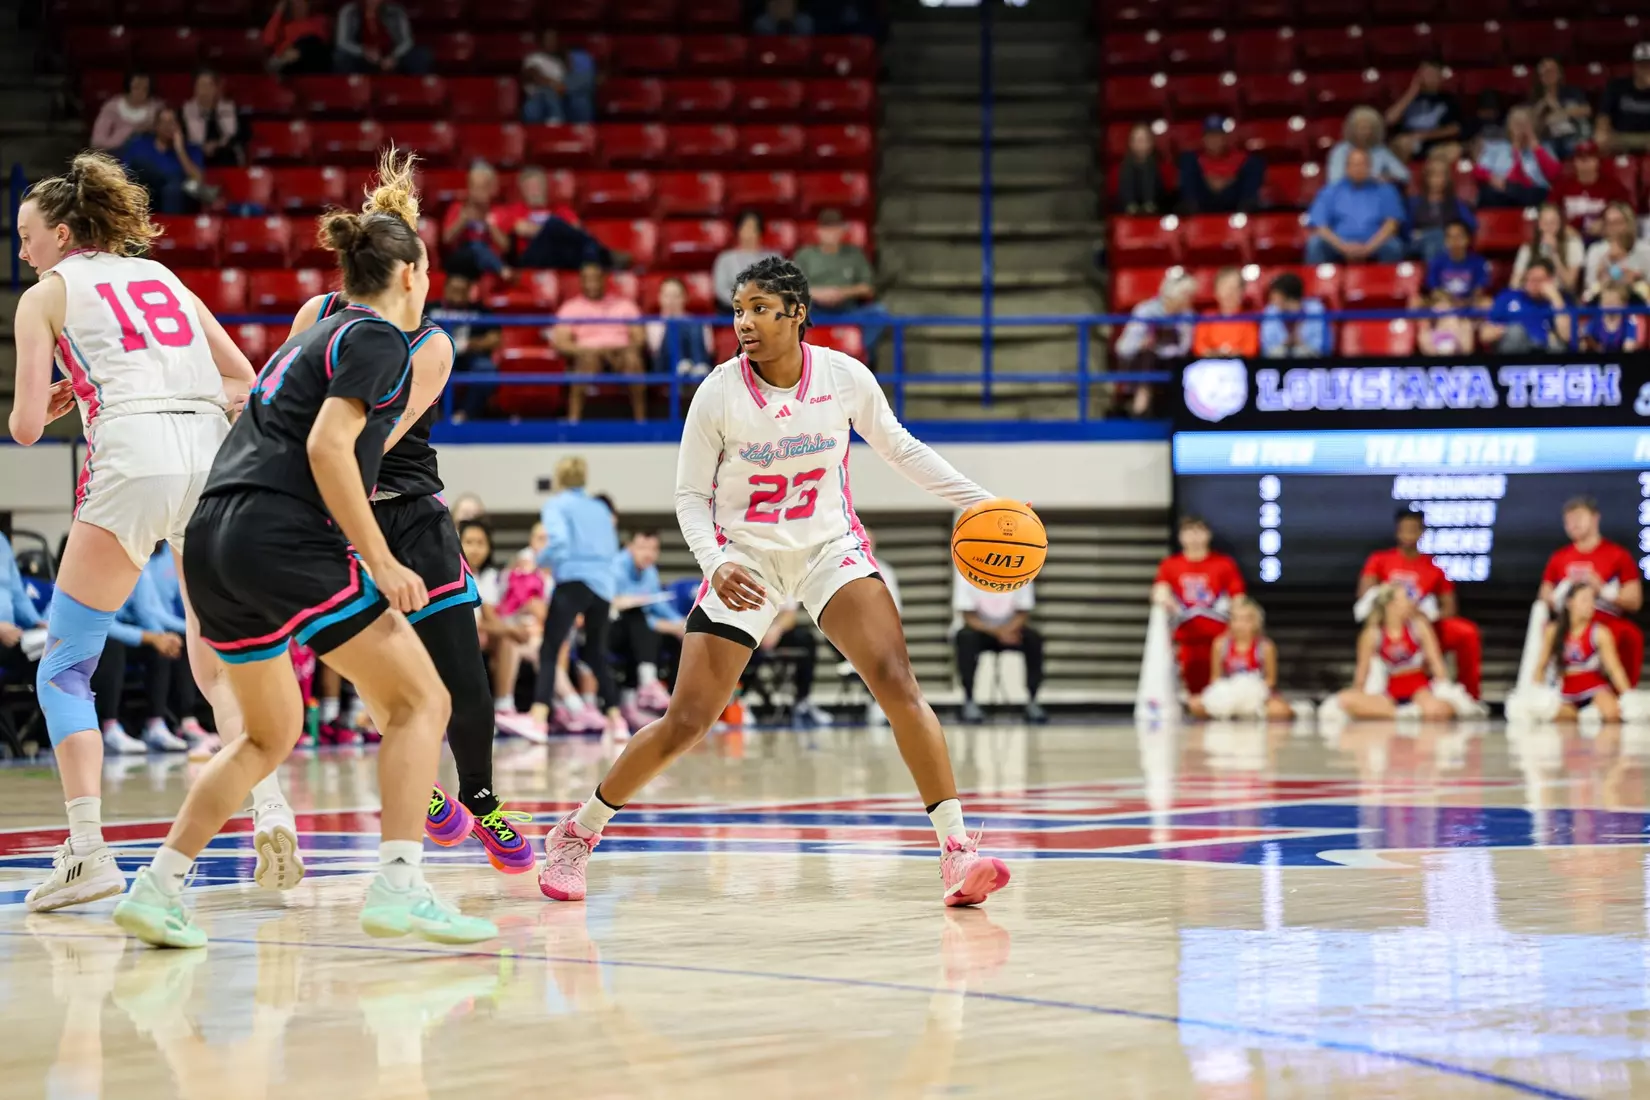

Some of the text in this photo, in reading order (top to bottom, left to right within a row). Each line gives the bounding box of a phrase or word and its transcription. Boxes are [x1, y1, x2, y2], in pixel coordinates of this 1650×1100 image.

[95, 280, 195, 353] 18
[1256, 364, 1622, 411] LOUISIANA TECH
[739, 433, 838, 469] Lady Techsters
[744, 467, 827, 524] 23
[983, 552, 1025, 568] EVO
[967, 570, 1031, 592] Wilson
